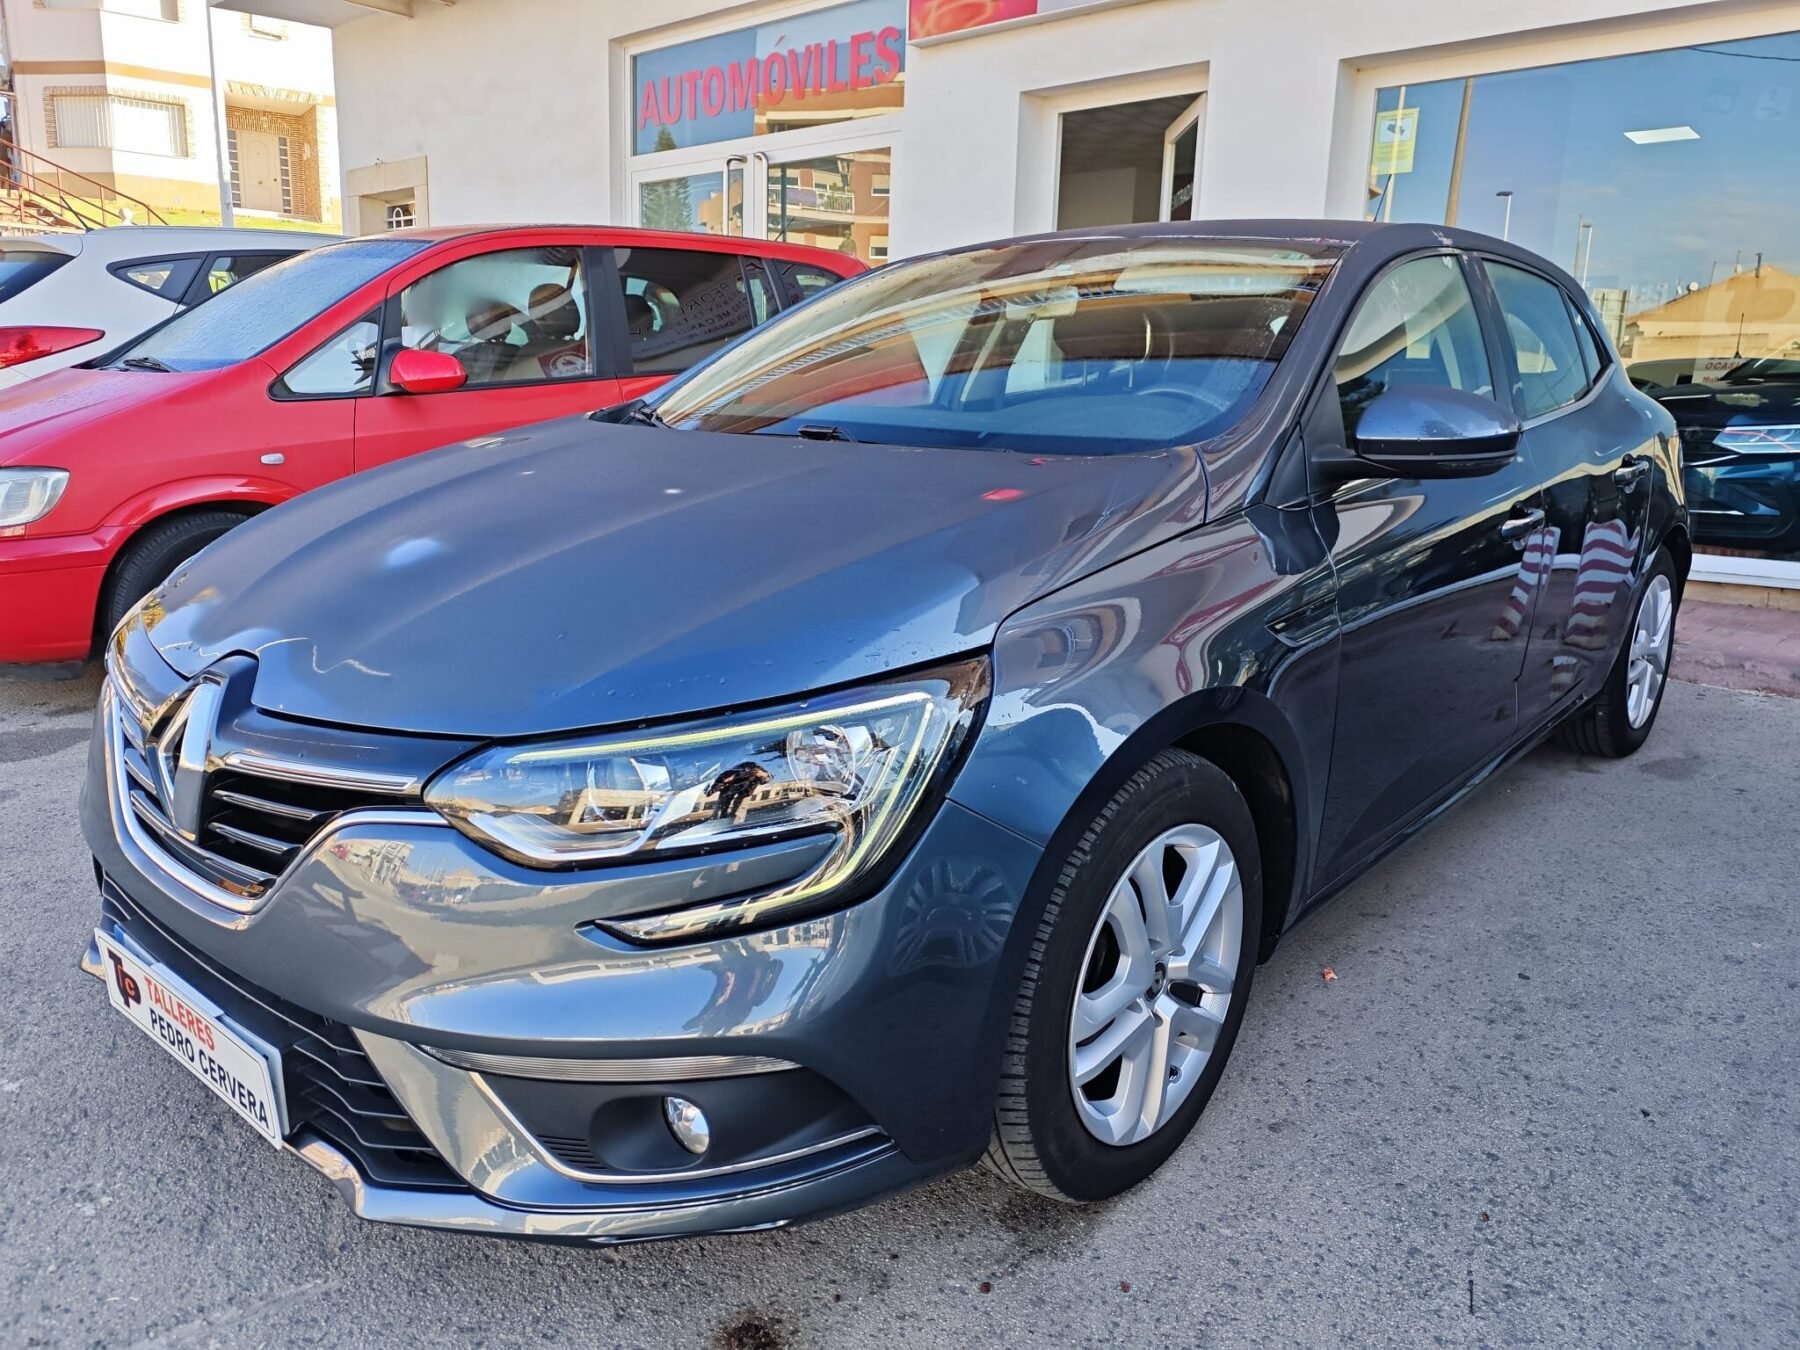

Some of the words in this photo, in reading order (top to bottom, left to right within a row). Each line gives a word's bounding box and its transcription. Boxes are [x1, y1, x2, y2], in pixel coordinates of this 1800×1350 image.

[640, 26, 900, 129] AUTOMÓVILES
[144, 975, 215, 1051] TALLERES
[149, 1007, 194, 1063] PEDRO
[199, 1049, 269, 1129] CERVERA
